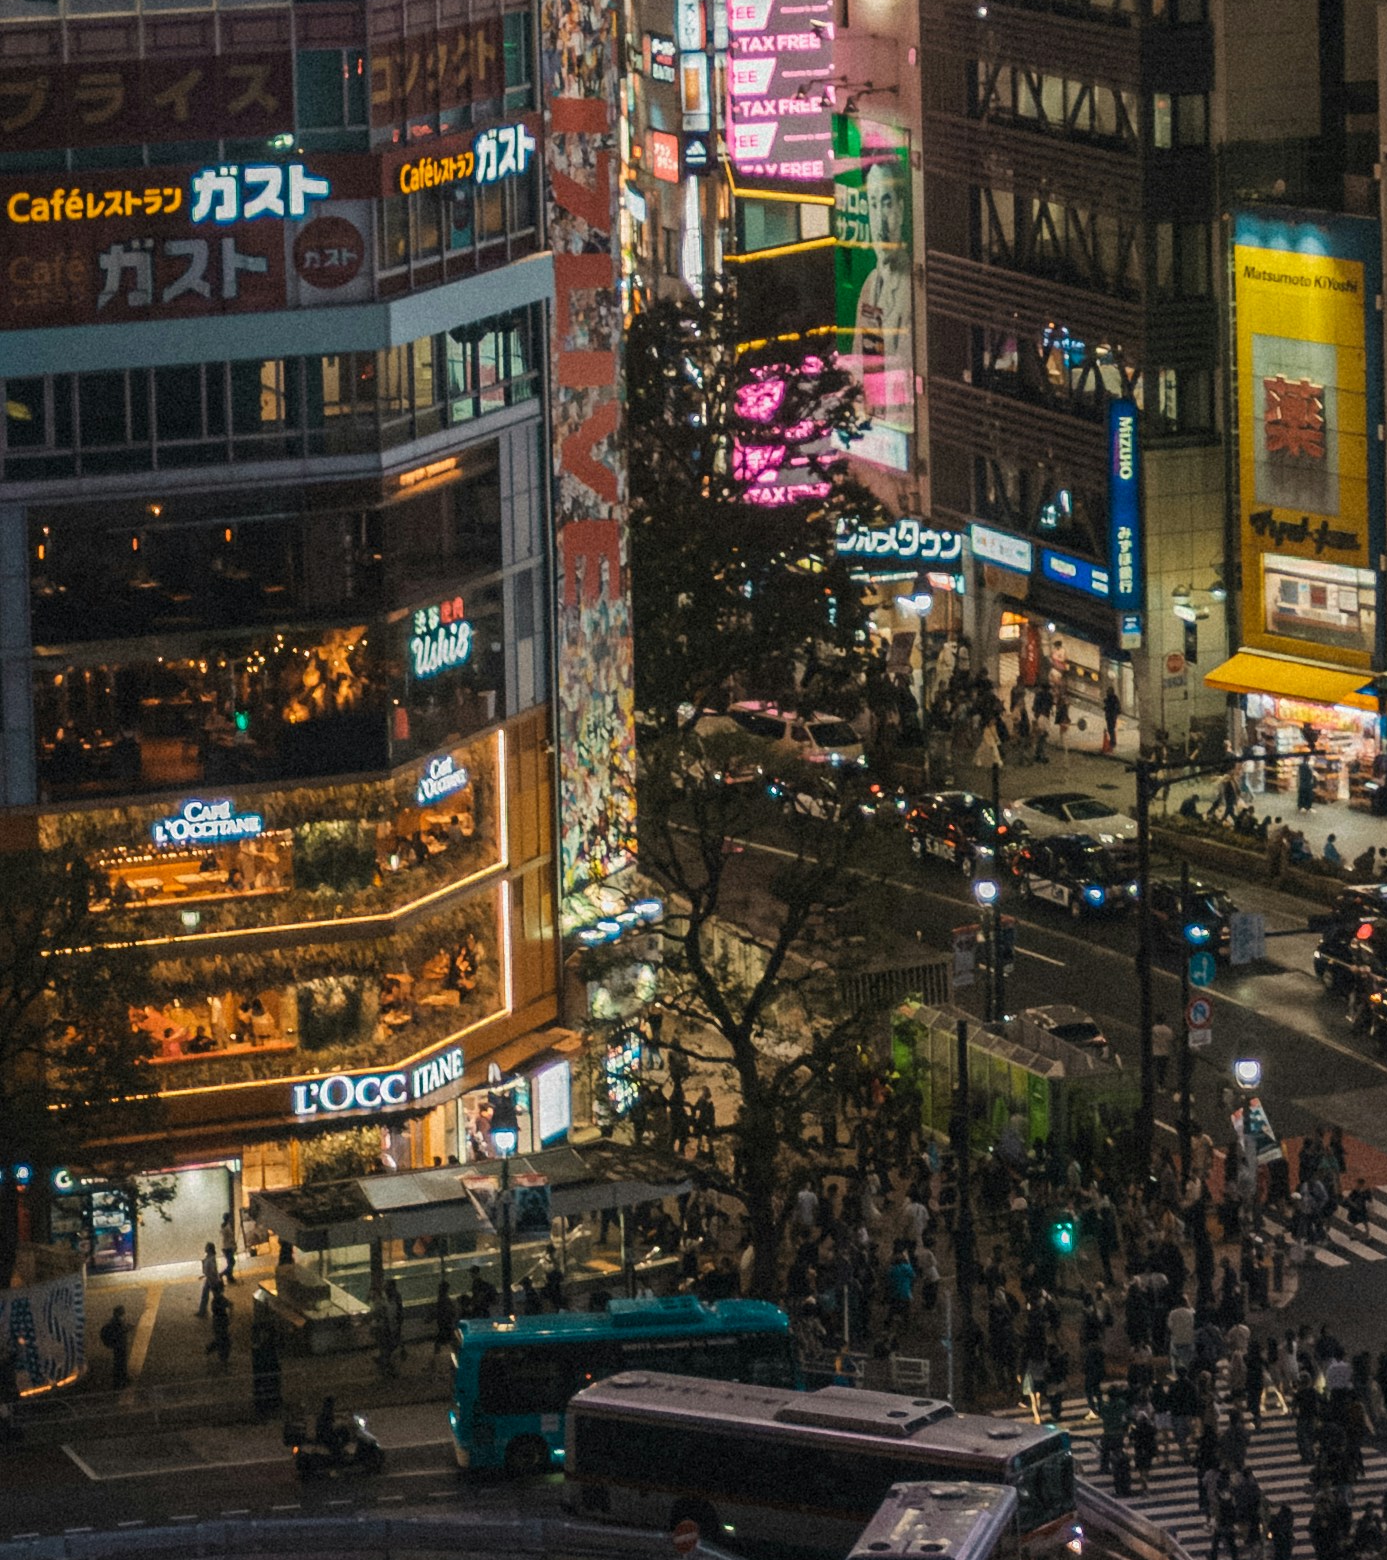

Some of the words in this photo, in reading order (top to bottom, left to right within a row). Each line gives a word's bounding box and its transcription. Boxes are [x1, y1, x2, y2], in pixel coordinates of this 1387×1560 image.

[738, 35, 775, 52] TAX
[777, 32, 822, 51] FREE
[740, 100, 777, 117] TAX
[778, 97, 823, 114] FREE
[475, 124, 536, 182] ガスト
[192, 164, 330, 220] ガスト
[101, 241, 267, 307] ガスト
[303, 247, 357, 268] ガスト
[1244, 266, 1311, 288] Matsumoto
[1119, 416, 1132, 480] MIZUHO
